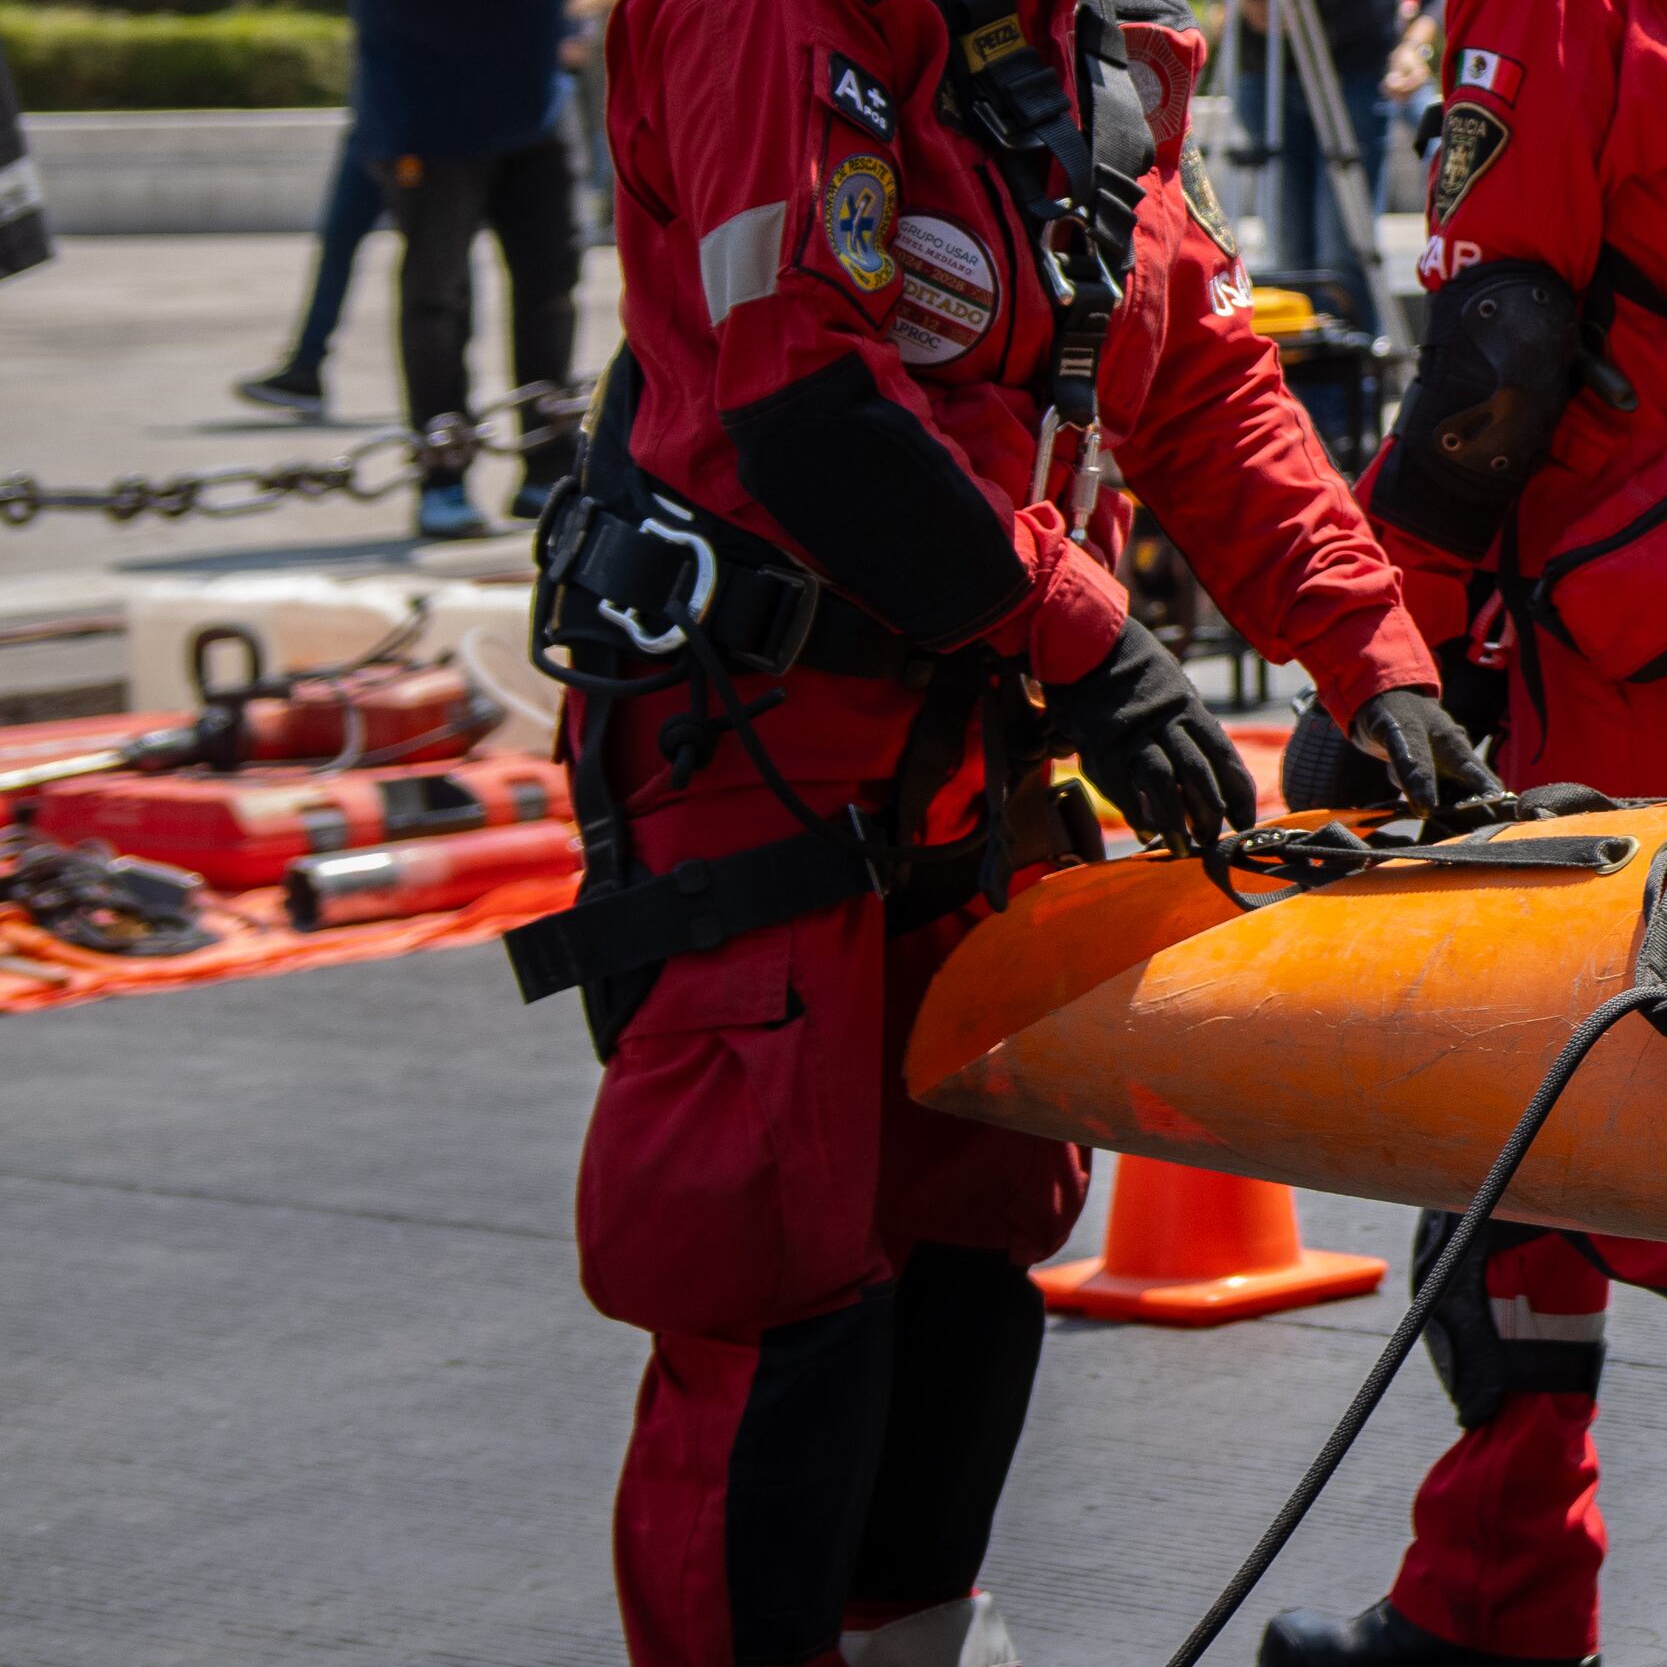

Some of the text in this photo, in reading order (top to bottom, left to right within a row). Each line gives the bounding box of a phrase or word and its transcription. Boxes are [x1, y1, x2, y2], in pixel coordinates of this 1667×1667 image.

[862, 104, 888, 131] POS
[899, 220, 944, 249] GRUPO
[945, 243, 979, 267] USAR
[925, 248, 974, 276] MEDIANO
[904, 279, 985, 326] DITADO
